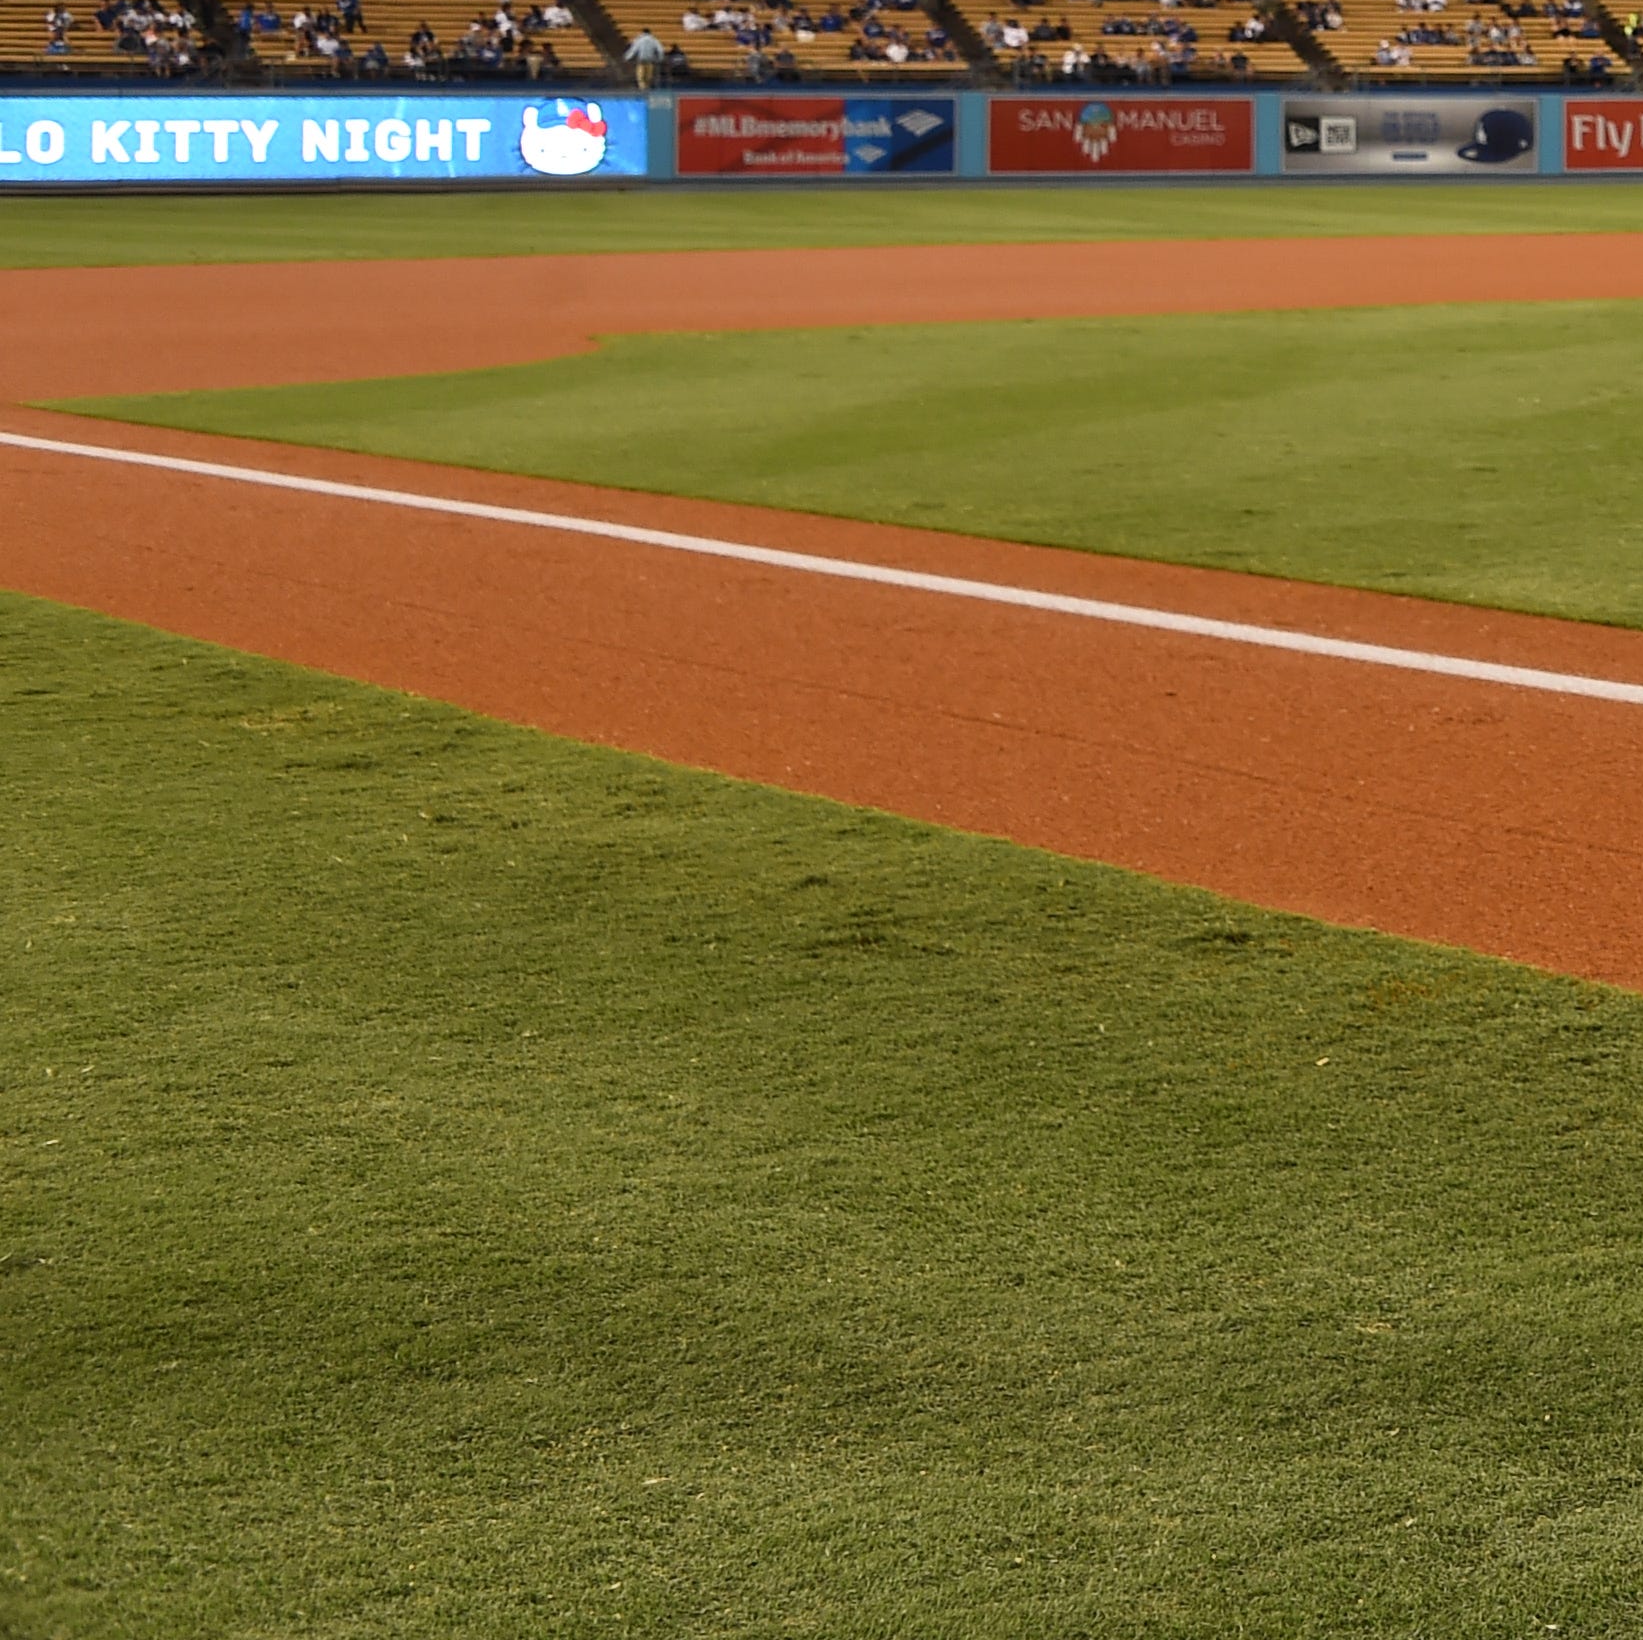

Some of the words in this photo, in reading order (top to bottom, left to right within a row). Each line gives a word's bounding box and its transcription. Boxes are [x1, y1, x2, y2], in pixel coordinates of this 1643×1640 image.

[91, 119, 279, 163] KITTY
[302, 118, 491, 162] NIGHT
[1018, 110, 1073, 131] SAN
[1117, 109, 1226, 131] MANUEL
[1571, 114, 1633, 157] Fly
